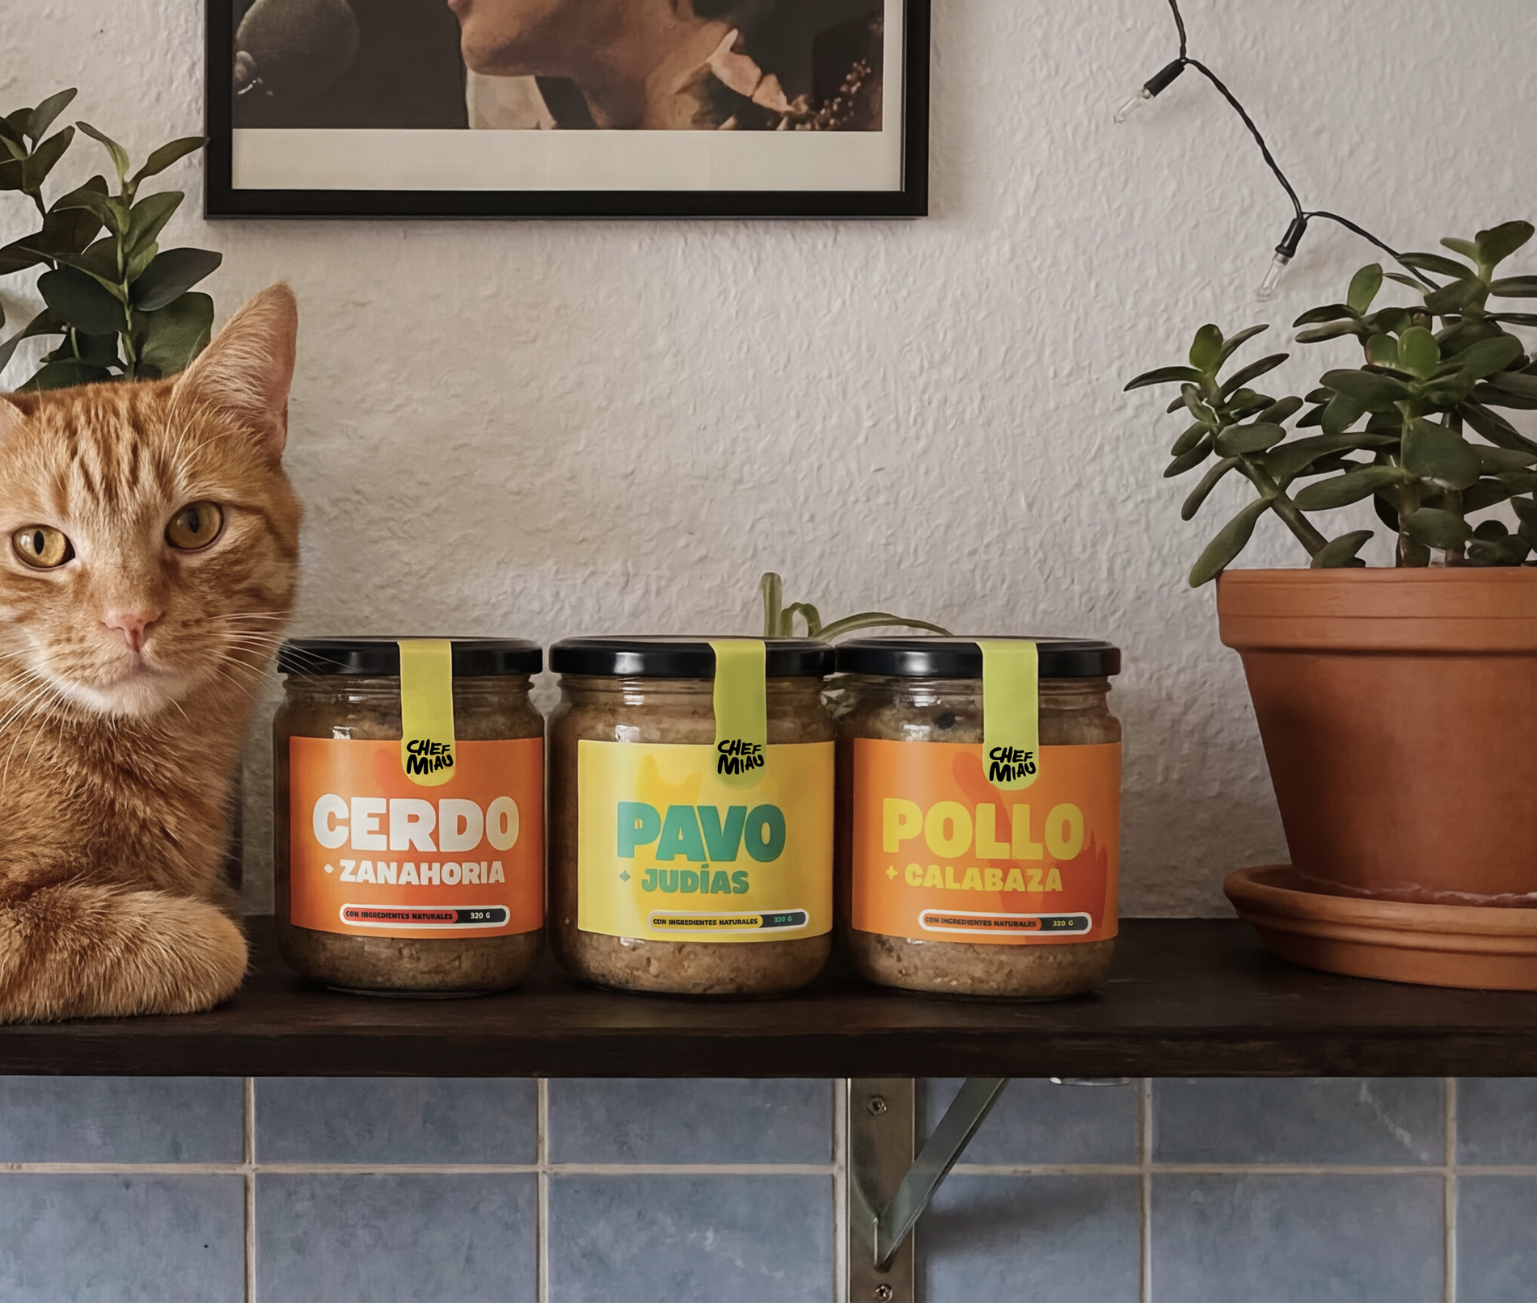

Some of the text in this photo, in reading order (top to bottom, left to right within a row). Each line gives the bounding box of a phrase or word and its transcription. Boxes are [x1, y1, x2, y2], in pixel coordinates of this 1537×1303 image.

[406, 739, 451, 756] CHEF
[717, 739, 762, 756] CHEF
[989, 746, 1033, 763] CHEF
[406, 753, 454, 775] MIAU
[717, 753, 765, 775] MIAU
[989, 761, 1036, 782] MIAU
[313, 793, 520, 852] CERDO
[616, 801, 786, 863] PAVO
[882, 797, 1084, 861] POLLO
[339, 859, 505, 885] ZANAHORIA
[641, 863, 750, 895] JUDÍAS
[904, 863, 1063, 892] CALABAZA
[345, 910, 359, 918] CON
[361, 911, 410, 920] INGREDIENTES
[470, 912, 484, 920] 320
[719, 918, 758, 926] NATURALES
[925, 916, 1037, 928] CON INGREDIENTES NATURALES
